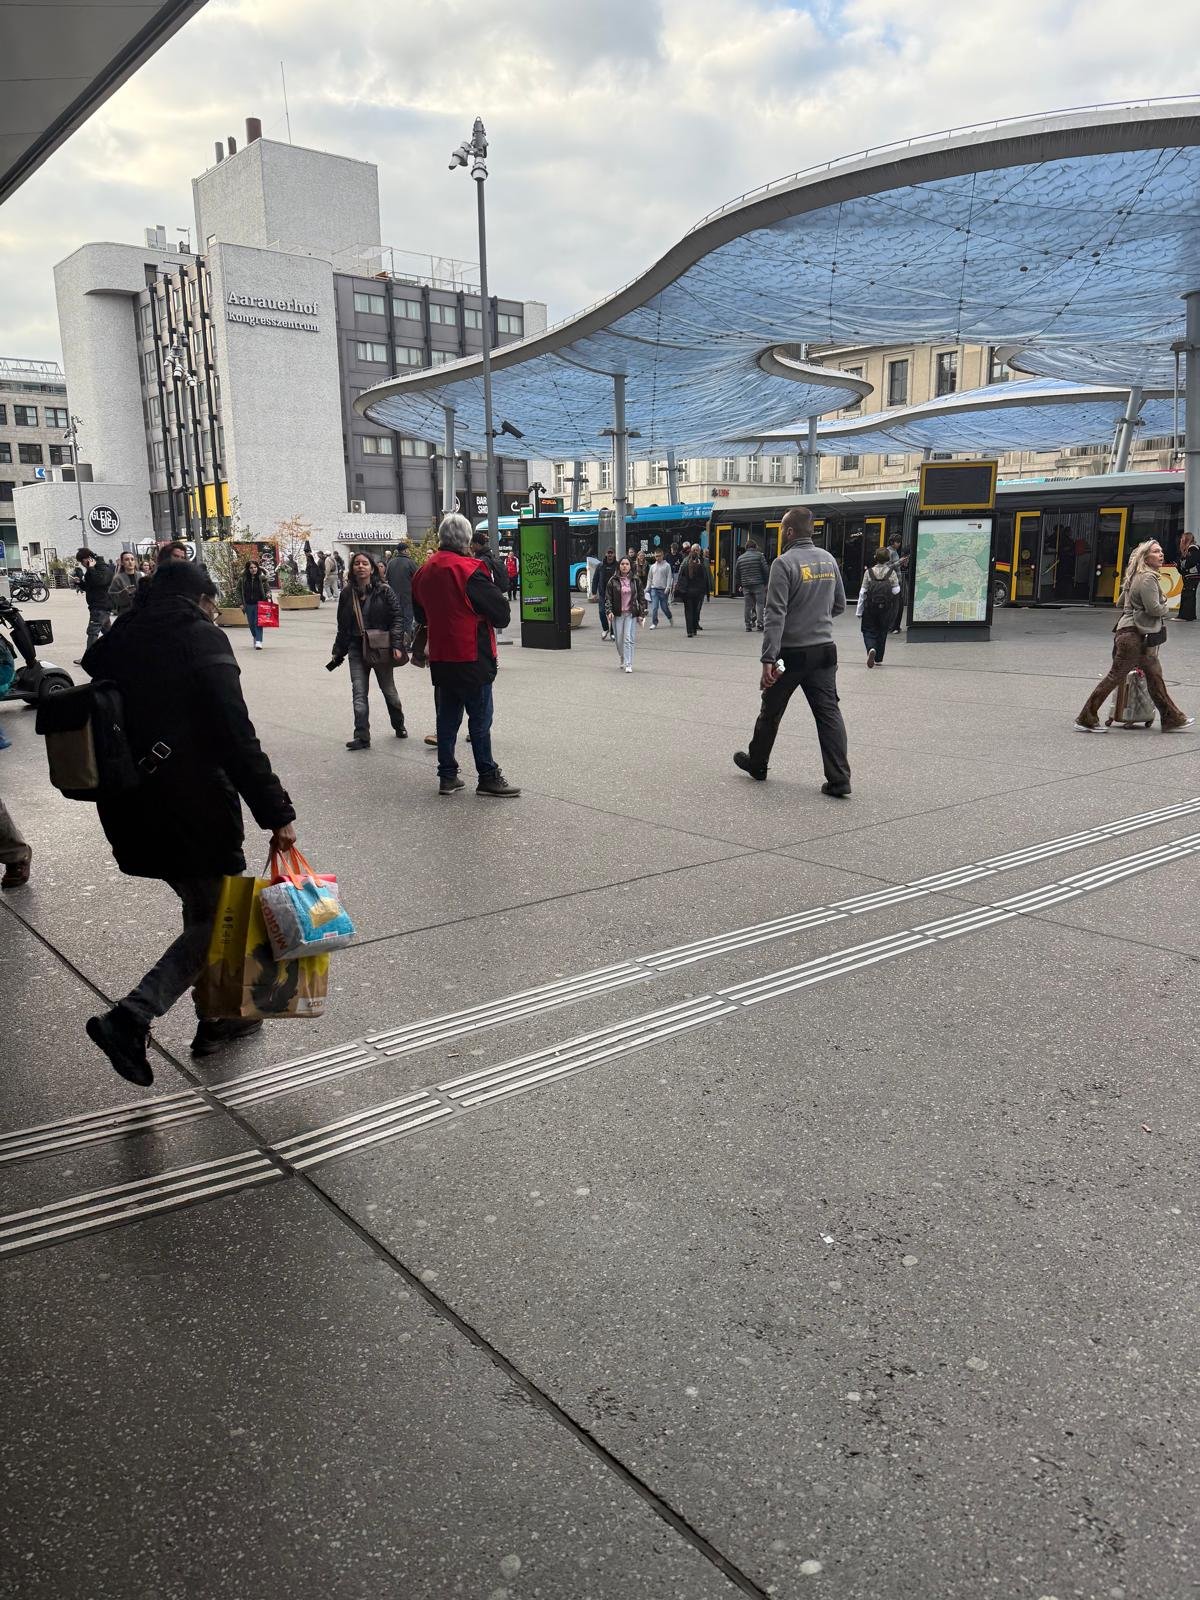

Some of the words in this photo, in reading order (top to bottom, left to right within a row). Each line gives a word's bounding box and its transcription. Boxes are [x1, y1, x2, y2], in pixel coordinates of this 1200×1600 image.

[227, 292, 318, 315] Aarauerhof
[227, 312, 320, 331] Kongresszentrum
[91, 511, 112, 521] GLEIS
[101, 519, 117, 529] BIER
[338, 530, 393, 540] Aarauerhof
